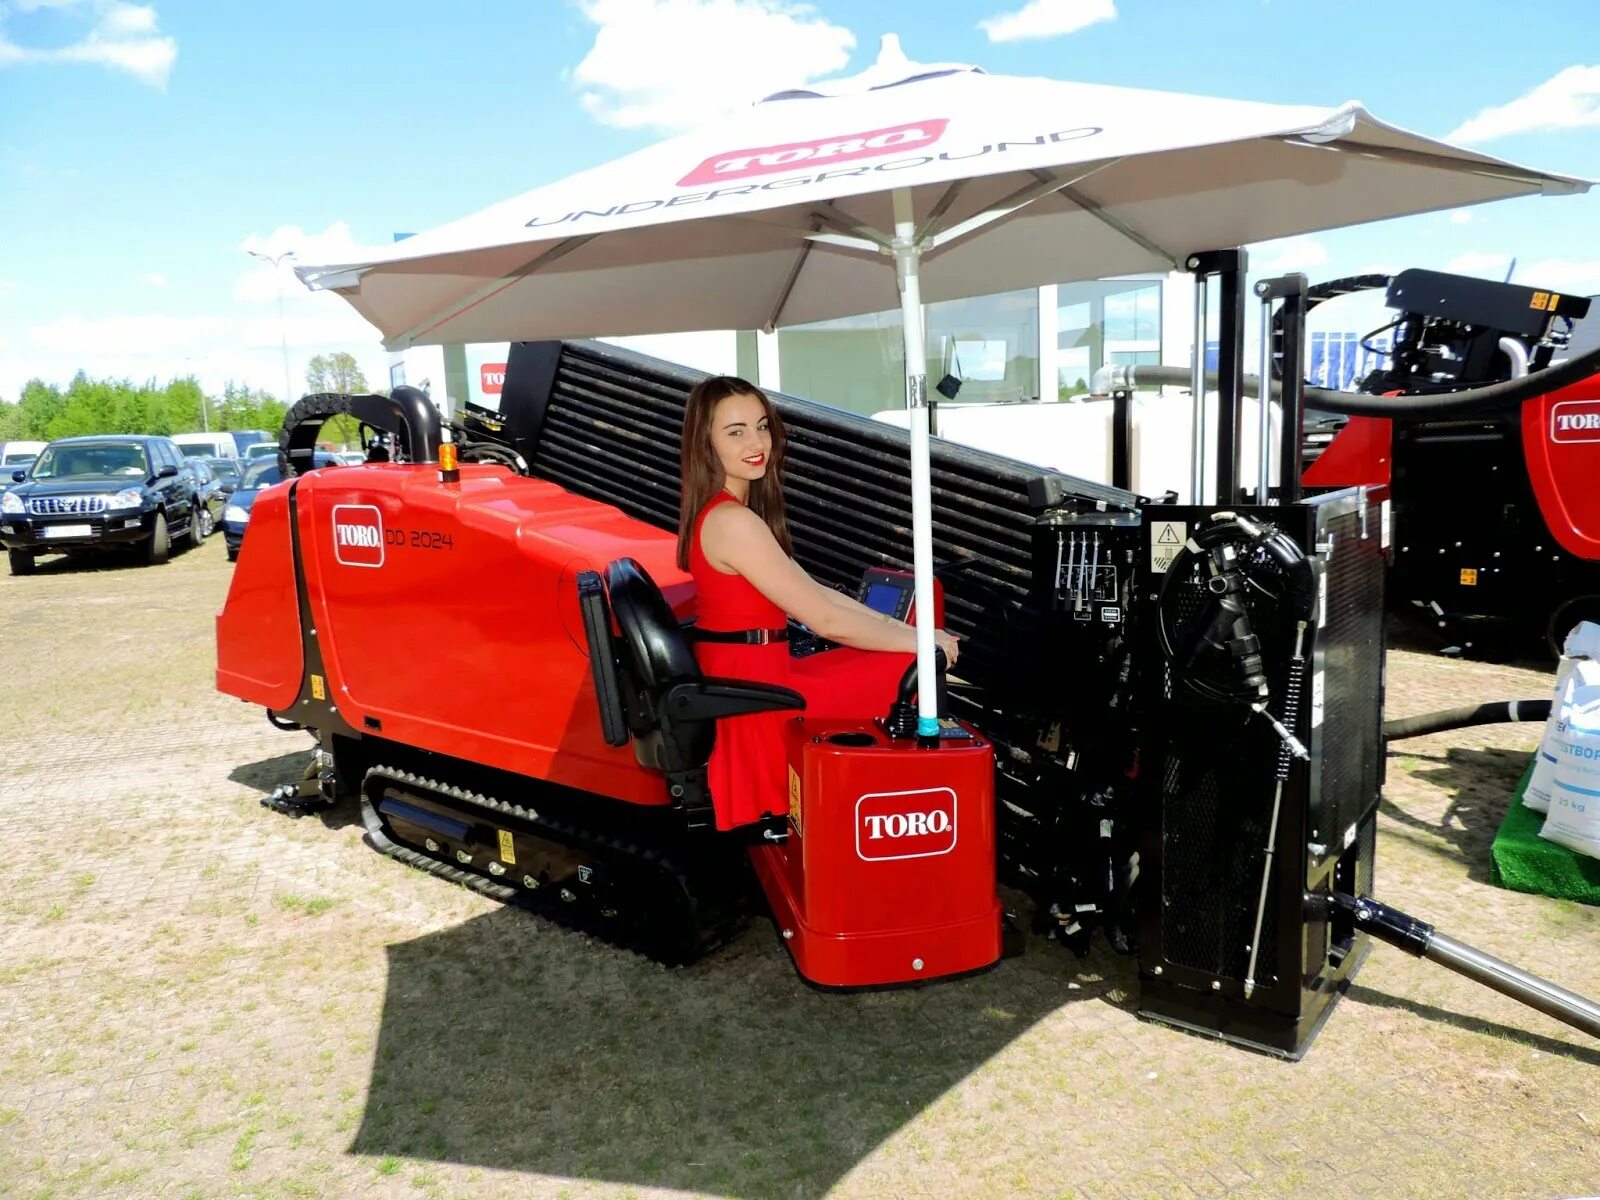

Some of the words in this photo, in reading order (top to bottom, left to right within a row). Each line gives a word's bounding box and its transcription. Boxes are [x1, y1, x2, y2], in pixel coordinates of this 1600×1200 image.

[713, 127, 932, 175] TORO
[524, 126, 1104, 229] UNDERGROUND
[483, 372, 506, 386] TO
[385, 529, 406, 546] DD
[410, 530, 454, 551] 2024
[1571, 800, 1585, 813] kg
